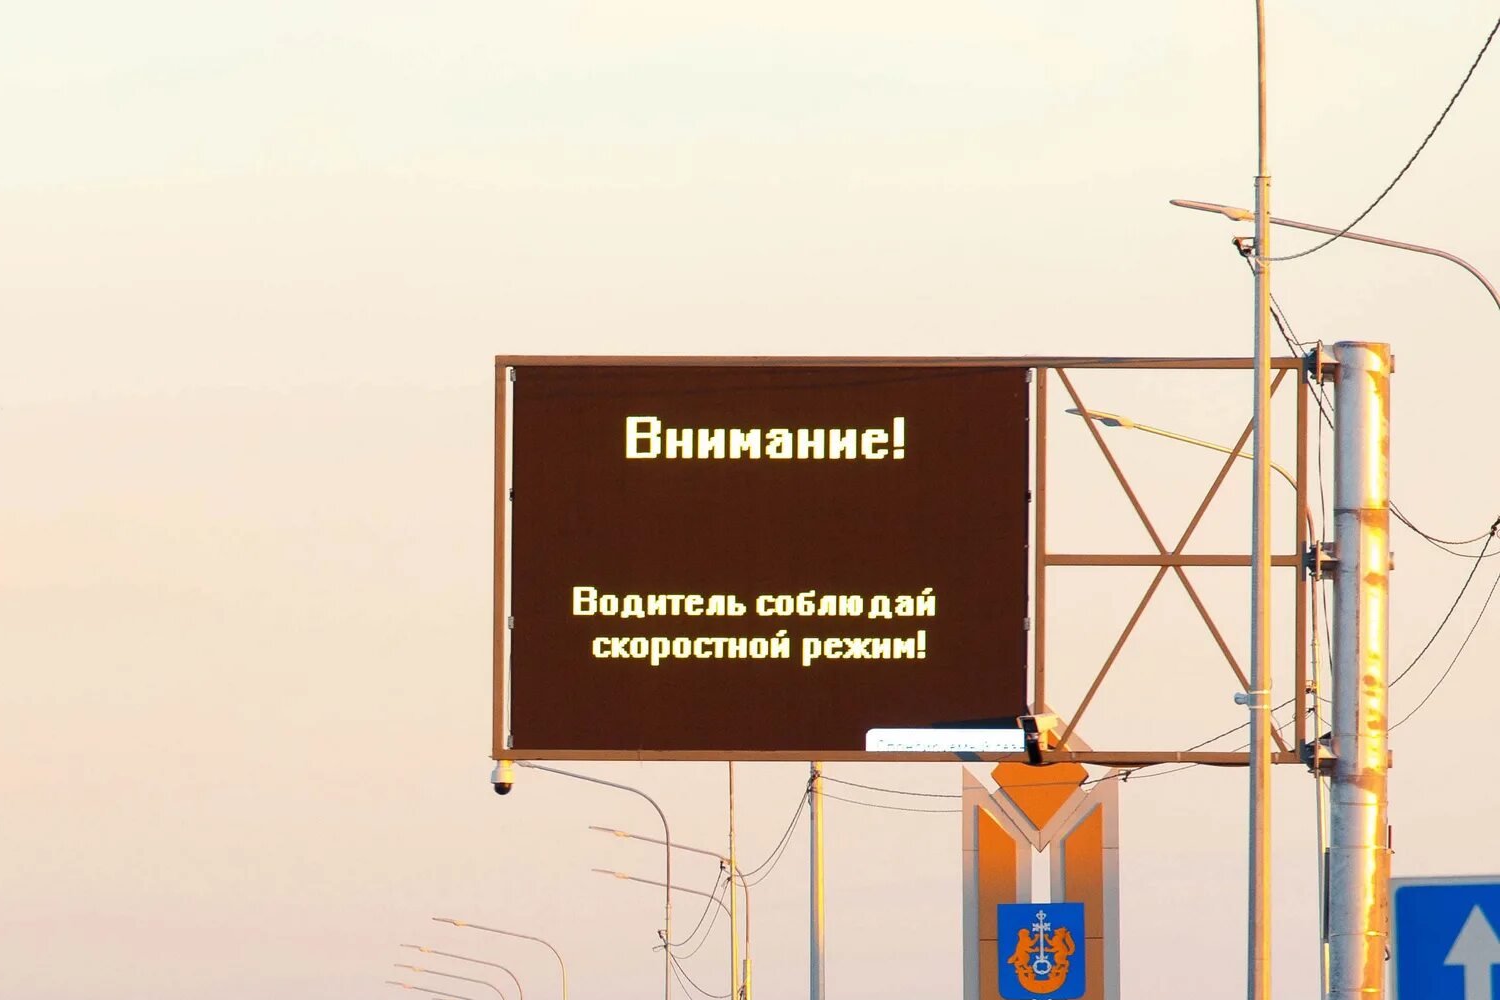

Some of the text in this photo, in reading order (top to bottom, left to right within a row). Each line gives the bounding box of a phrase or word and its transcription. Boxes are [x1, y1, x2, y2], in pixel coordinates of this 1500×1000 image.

[626, 416, 905, 460] Внимание!
[573, 587, 936, 619] Водитель соблюдай
[593, 630, 926, 666] скоростной режим!
